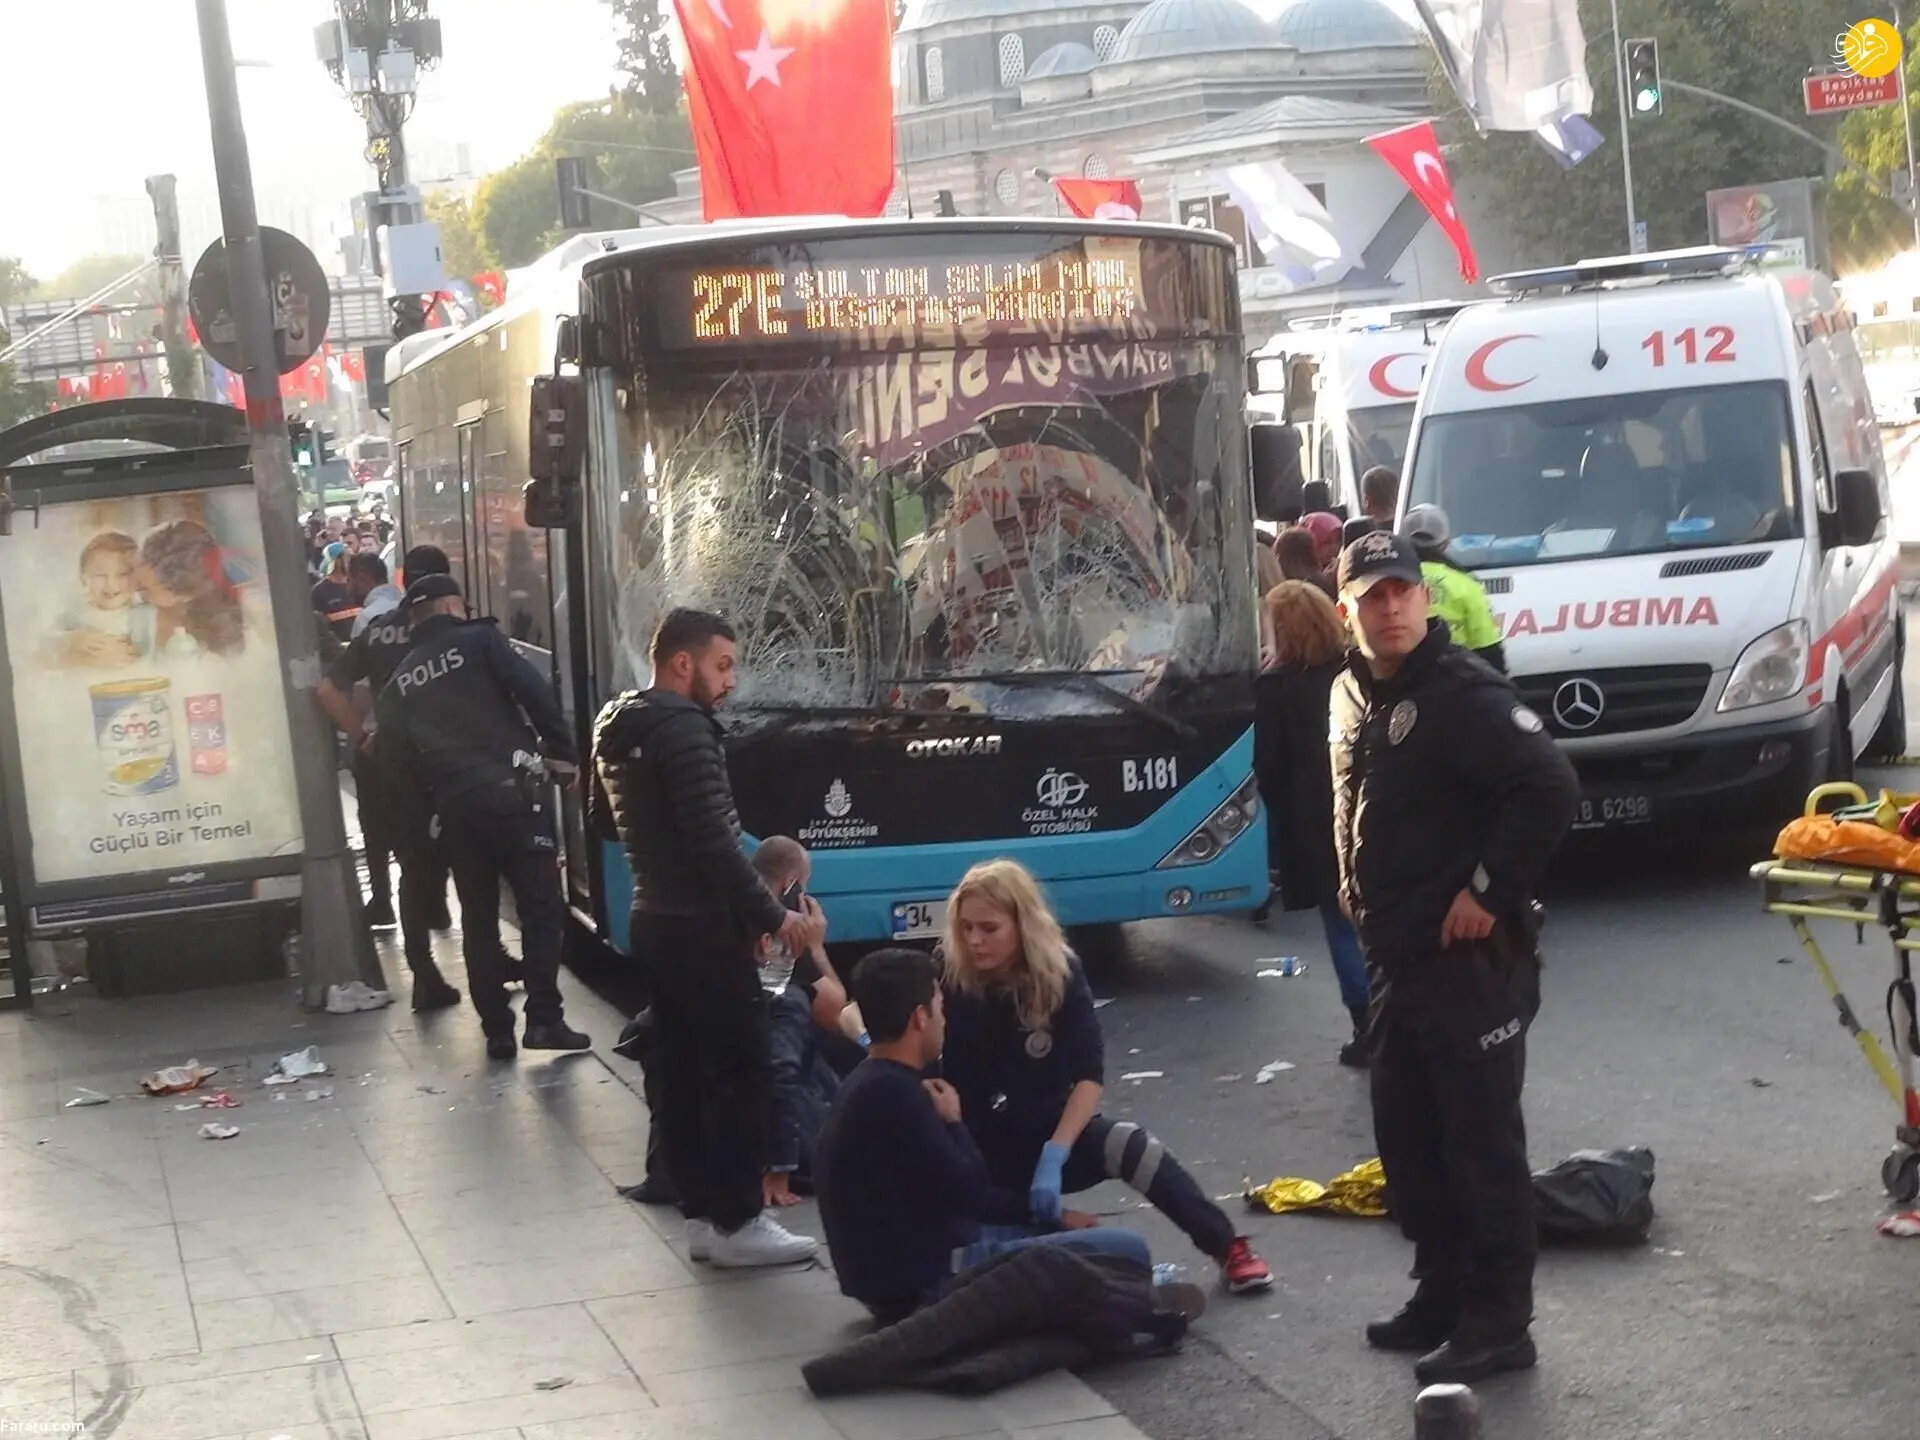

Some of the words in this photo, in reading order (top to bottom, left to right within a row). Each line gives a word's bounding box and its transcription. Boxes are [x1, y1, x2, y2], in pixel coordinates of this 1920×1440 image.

[795, 267, 929, 300] SULTAN
[693, 271, 788, 338] 27E
[1641, 325, 1737, 367] 112
[368, 623, 416, 646] POL
[111, 720, 160, 741] sma
[906, 735, 1003, 758] OTOKAR
[1122, 756, 1178, 793] B.181
[113, 808, 181, 828] Yaşam
[186, 801, 222, 821] için
[1022, 808, 1059, 822] ÖZEL
[1062, 806, 1099, 820] HALK
[1602, 796, 1648, 819] 6298
[89, 831, 149, 854] Güçlü
[155, 828, 184, 847] Bir
[189, 820, 252, 843] Temel
[1030, 820, 1092, 835] OTOBÜSÜ
[907, 905, 933, 928] 34
